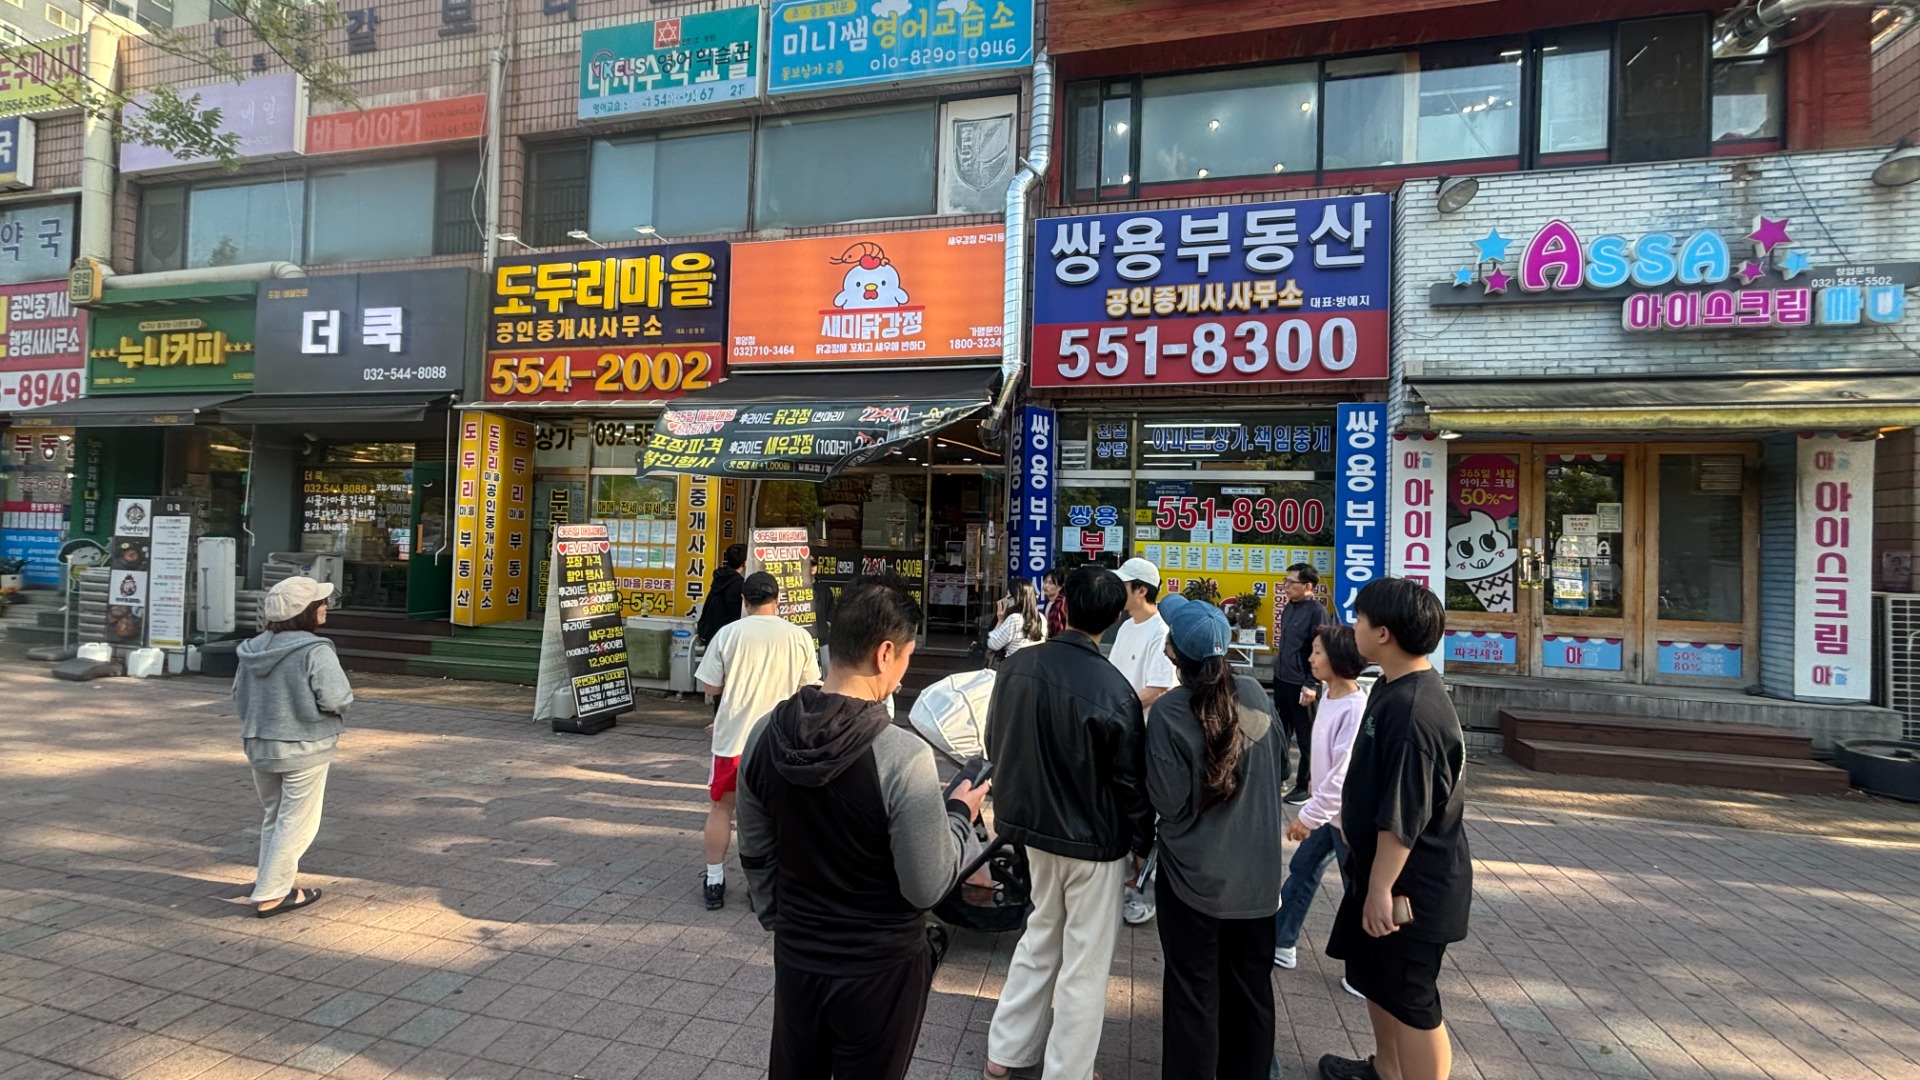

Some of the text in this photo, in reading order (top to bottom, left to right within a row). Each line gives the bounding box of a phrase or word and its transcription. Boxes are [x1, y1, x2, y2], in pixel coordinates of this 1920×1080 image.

[783, 2, 1016, 56] 미니쌤 영어교습소
[870, 39, 1016, 71] 010-8290-0946
[313, 107, 422, 149] 바늘이야기
[1051, 202, 1373, 285] 쌍용부동산
[1519, 219, 1731, 292] ASSA
[1836, 266, 1875, 276] 창업문의
[494, 252, 715, 315] 도두리마을
[1626, 287, 1812, 330] 아이스크림
[302, 307, 403, 354] 더 쿡
[496, 314, 663, 344] 공인중개사사무소
[821, 312, 922, 340] 새미닭강정
[118, 331, 226, 368] 누나커피
[733, 345, 795, 356] 032)710-3464
[949, 338, 1002, 350] 1800-3234
[1057, 317, 1358, 379] 551-8300
[364, 366, 447, 380] 032-544-8088
[490, 351, 712, 395] 554-2002
[0, 371, 80, 407] -8949
[664, 409, 738, 423] 365일 매일매일
[739, 412, 774, 425] 후라이드
[773, 409, 813, 426] 닭강정
[811, 409, 845, 423] (한마리)
[537, 427, 575, 450] 상가
[675, 422, 713, 435] EVENT
[1097, 424, 1127, 439] 친절
[487, 425, 501, 470] 도두리
[648, 434, 724, 455] 포장파격
[729, 441, 764, 456] 후라이드
[764, 434, 814, 456] 새우강정
[1096, 442, 1127, 457] 상담
[462, 423, 477, 498] 도두리
[512, 430, 527, 502] 도두리
[643, 450, 716, 470] 할인행사
[1460, 468, 1515, 479] 365일 세일
[1460, 478, 1515, 488] 아이스 크림
[1068, 505, 1118, 527] 쌍용
[1156, 495, 1324, 534] 551-8300
[480, 483, 497, 609] 공인중개사사무소
[567, 541, 600, 555] EVENT
[764, 547, 800, 560] EVENT
[1081, 531, 1104, 560] 부
[456, 531, 473, 608] 부동산
[507, 532, 522, 606] 부동산
[565, 555, 602, 568] 포장 가격
[765, 561, 801, 574] 포장 가격
[1814, 481, 1852, 656] 아이스크림
[566, 568, 604, 582] 할인 행사
[644, 579, 673, 590] 공인중
[785, 575, 803, 588] 행사
[558, 581, 615, 596] 후라이드 닭강정
[788, 588, 813, 602] 닭강정
[562, 620, 593, 632] 후라이드
[588, 626, 624, 641] 새우강정
[1454, 647, 1503, 661] 파격세일
